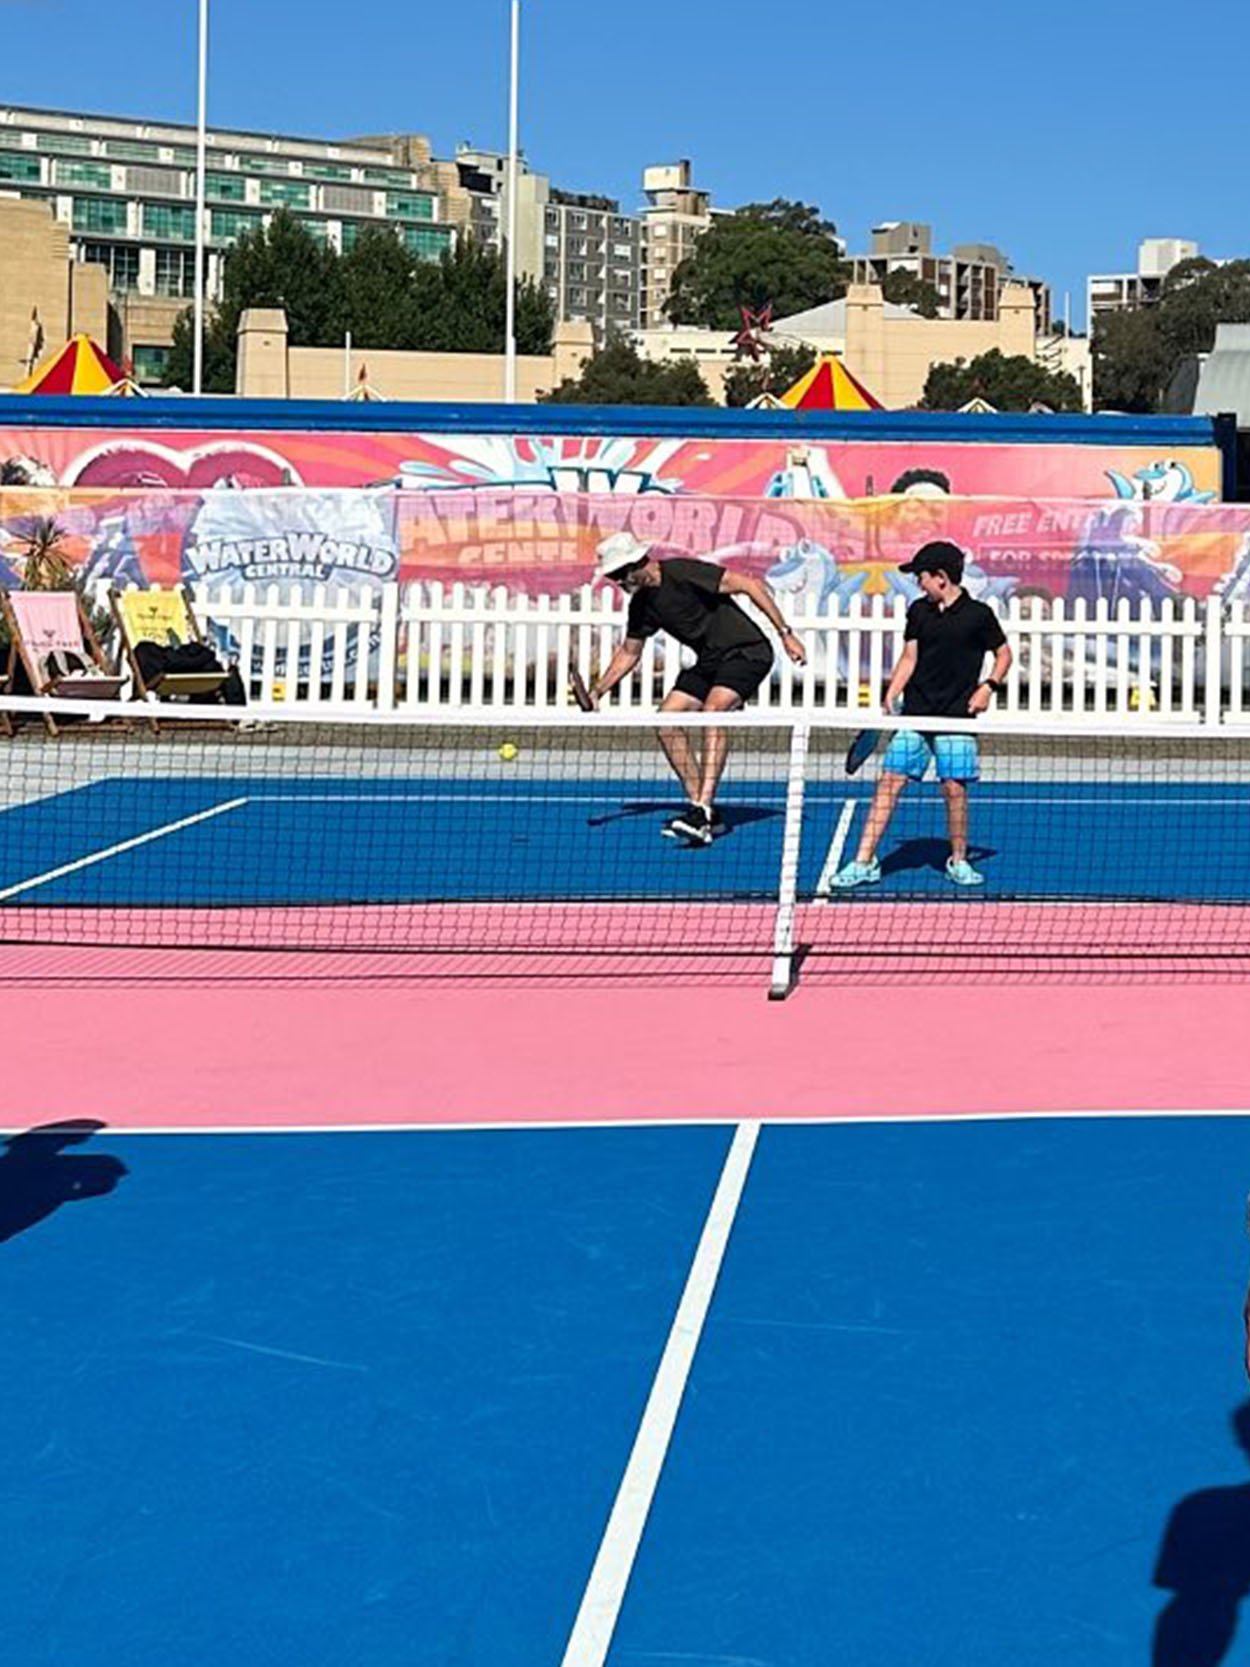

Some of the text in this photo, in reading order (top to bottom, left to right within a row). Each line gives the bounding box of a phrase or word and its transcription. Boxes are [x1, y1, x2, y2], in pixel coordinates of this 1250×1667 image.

[396, 467, 804, 552] ATERWORLD
[973, 512, 1032, 538] FREE
[244, 562, 326, 580] CENTRAL
